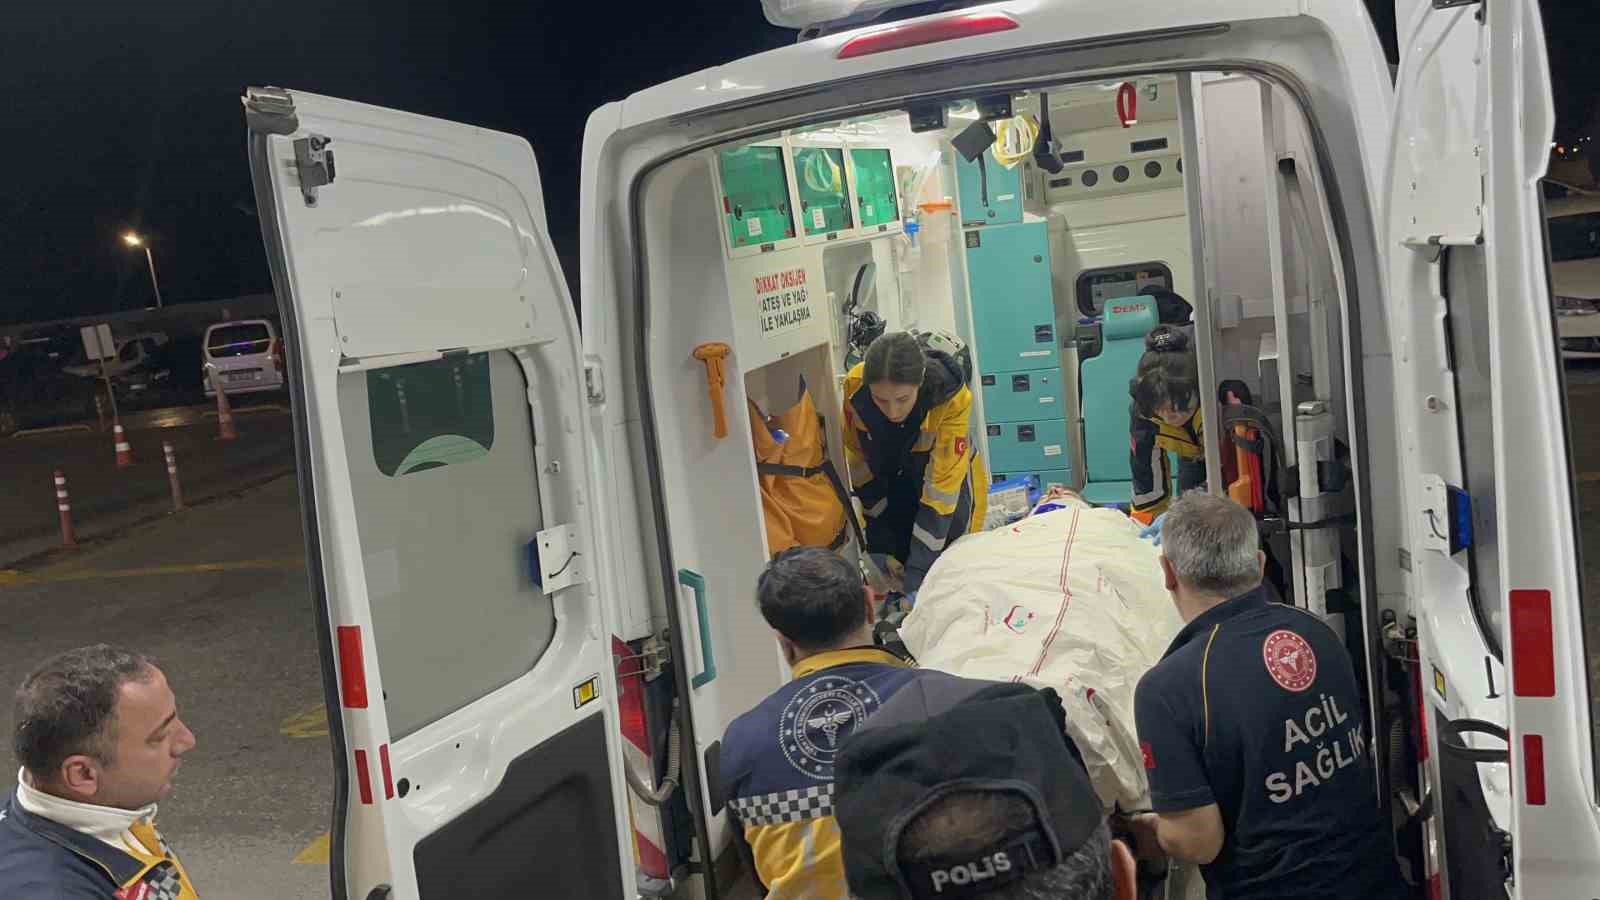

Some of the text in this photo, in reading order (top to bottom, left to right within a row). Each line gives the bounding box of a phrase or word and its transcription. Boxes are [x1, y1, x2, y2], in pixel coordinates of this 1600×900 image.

[774, 306, 811, 329] YAKLAŞMA
[782, 292, 791, 307] VE
[1285, 693, 1348, 753] ACİL
[1265, 722, 1365, 803] SAĞLIK
[931, 852, 1011, 892] POLİS
